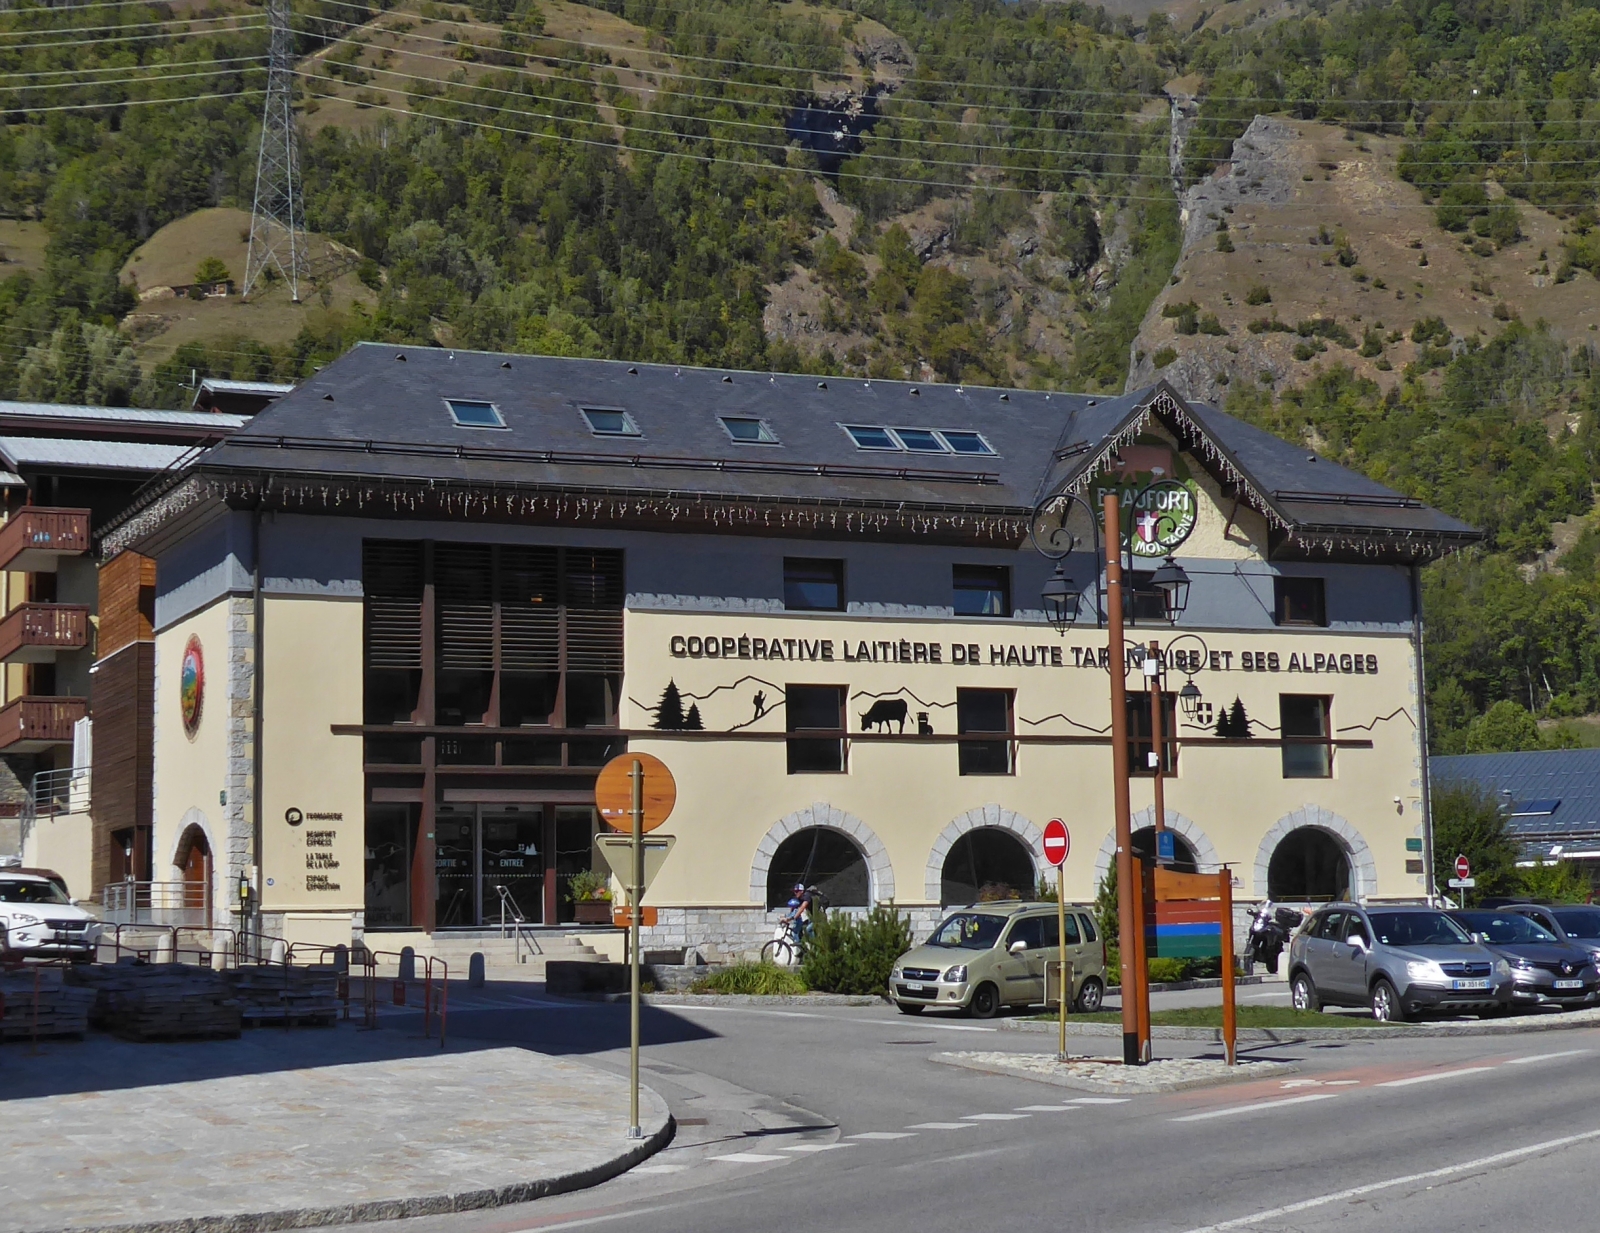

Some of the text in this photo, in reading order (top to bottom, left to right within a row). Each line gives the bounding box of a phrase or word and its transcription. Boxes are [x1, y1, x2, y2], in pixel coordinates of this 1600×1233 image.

[1097, 487, 1189, 511] BAUFORT
[670, 632, 834, 662] COOPÉRATIVE
[842, 637, 942, 664] LAITIÈRE
[951, 643, 980, 665] DE
[989, 644, 1063, 667] HAUTE
[1209, 650, 1233, 671] ET
[1241, 651, 1280, 672] SES
[1288, 652, 1378, 674] ALPAGES
